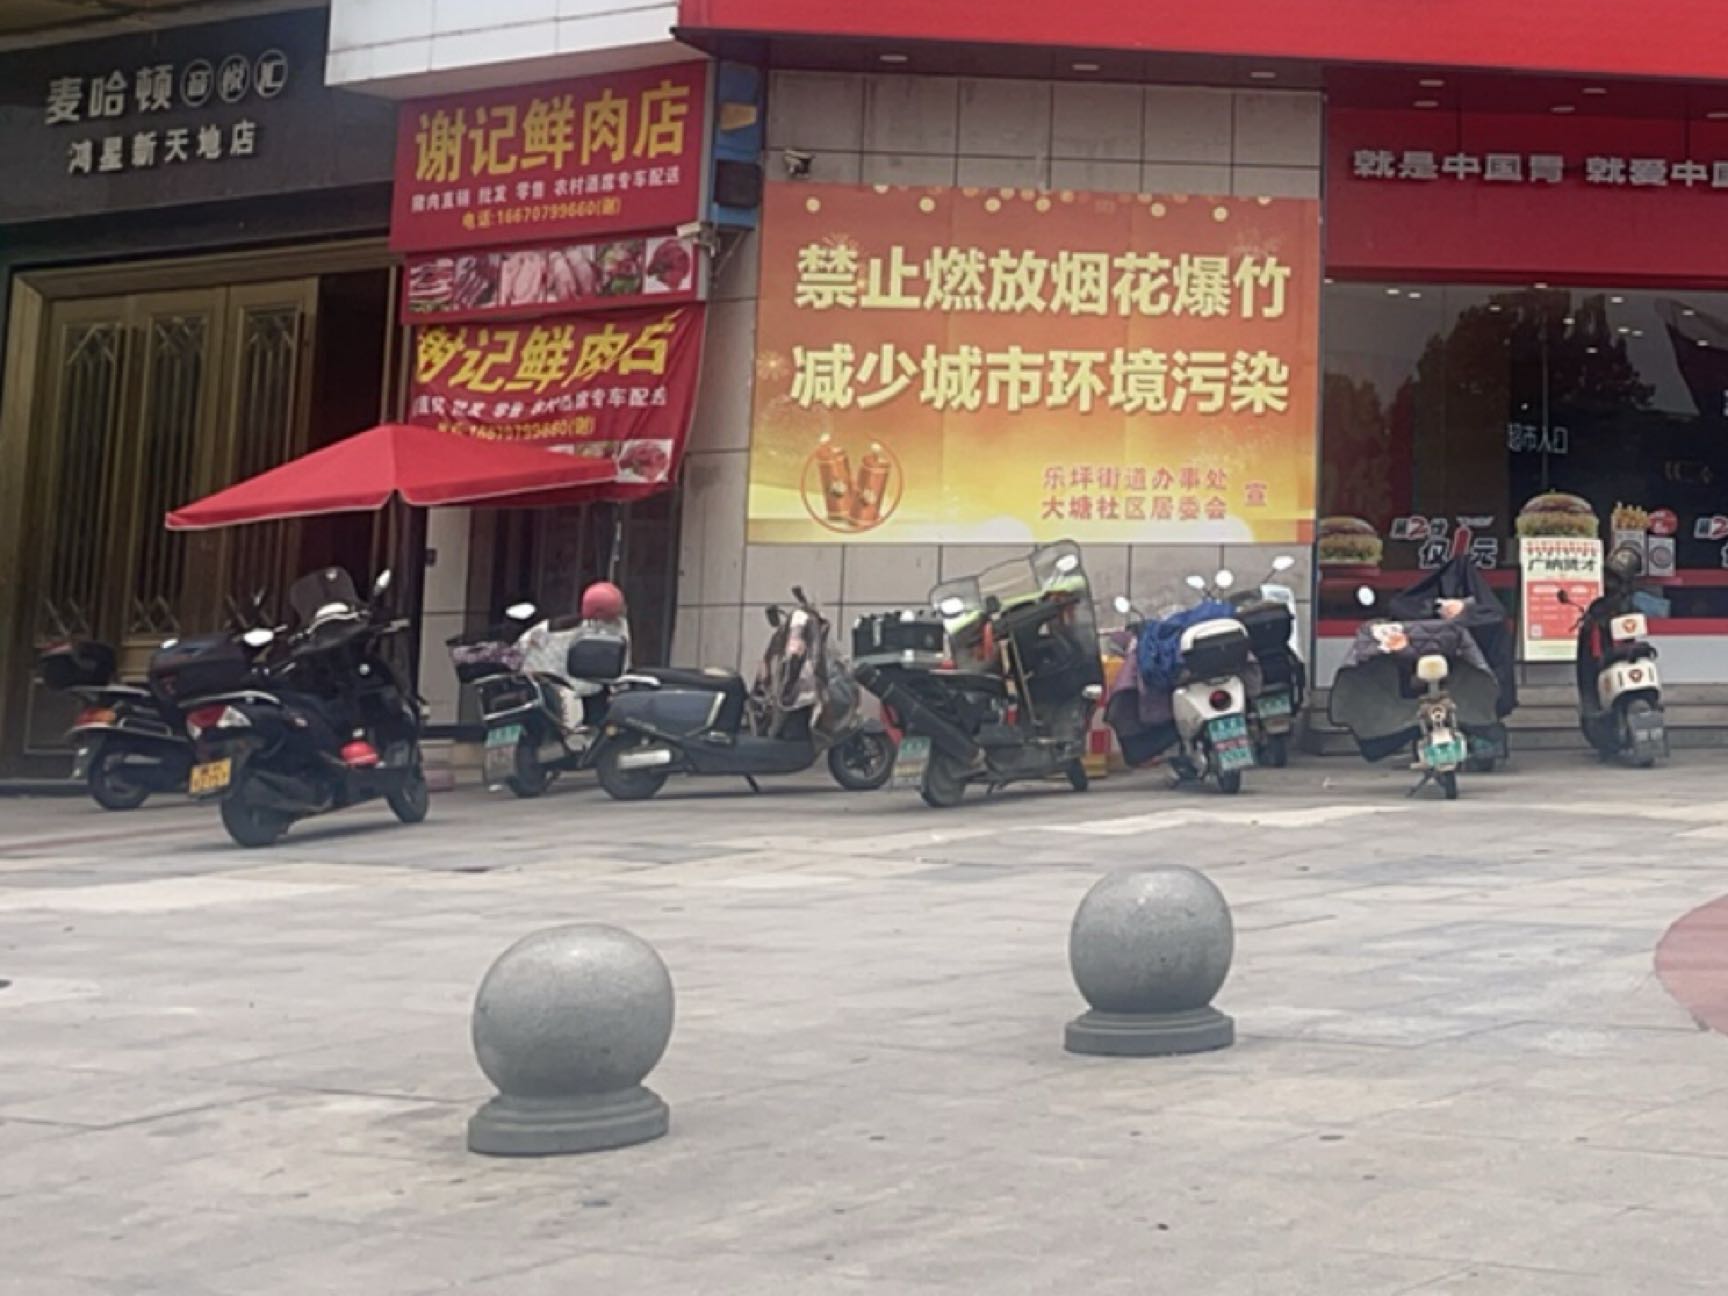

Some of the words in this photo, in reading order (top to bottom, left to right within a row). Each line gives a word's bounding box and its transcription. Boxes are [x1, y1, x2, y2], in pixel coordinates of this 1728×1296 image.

[68, 118, 256, 174] 鸿星新天地店
[415, 80, 690, 182] 谢记鲜肉店
[794, 244, 1291, 320] 禁止燃放烟花爆竹
[790, 343, 1290, 414] 减少城市环境污染
[1042, 495, 1228, 521] 大塘社区居委会
[1043, 465, 1228, 491] 乐坪街道办事处
